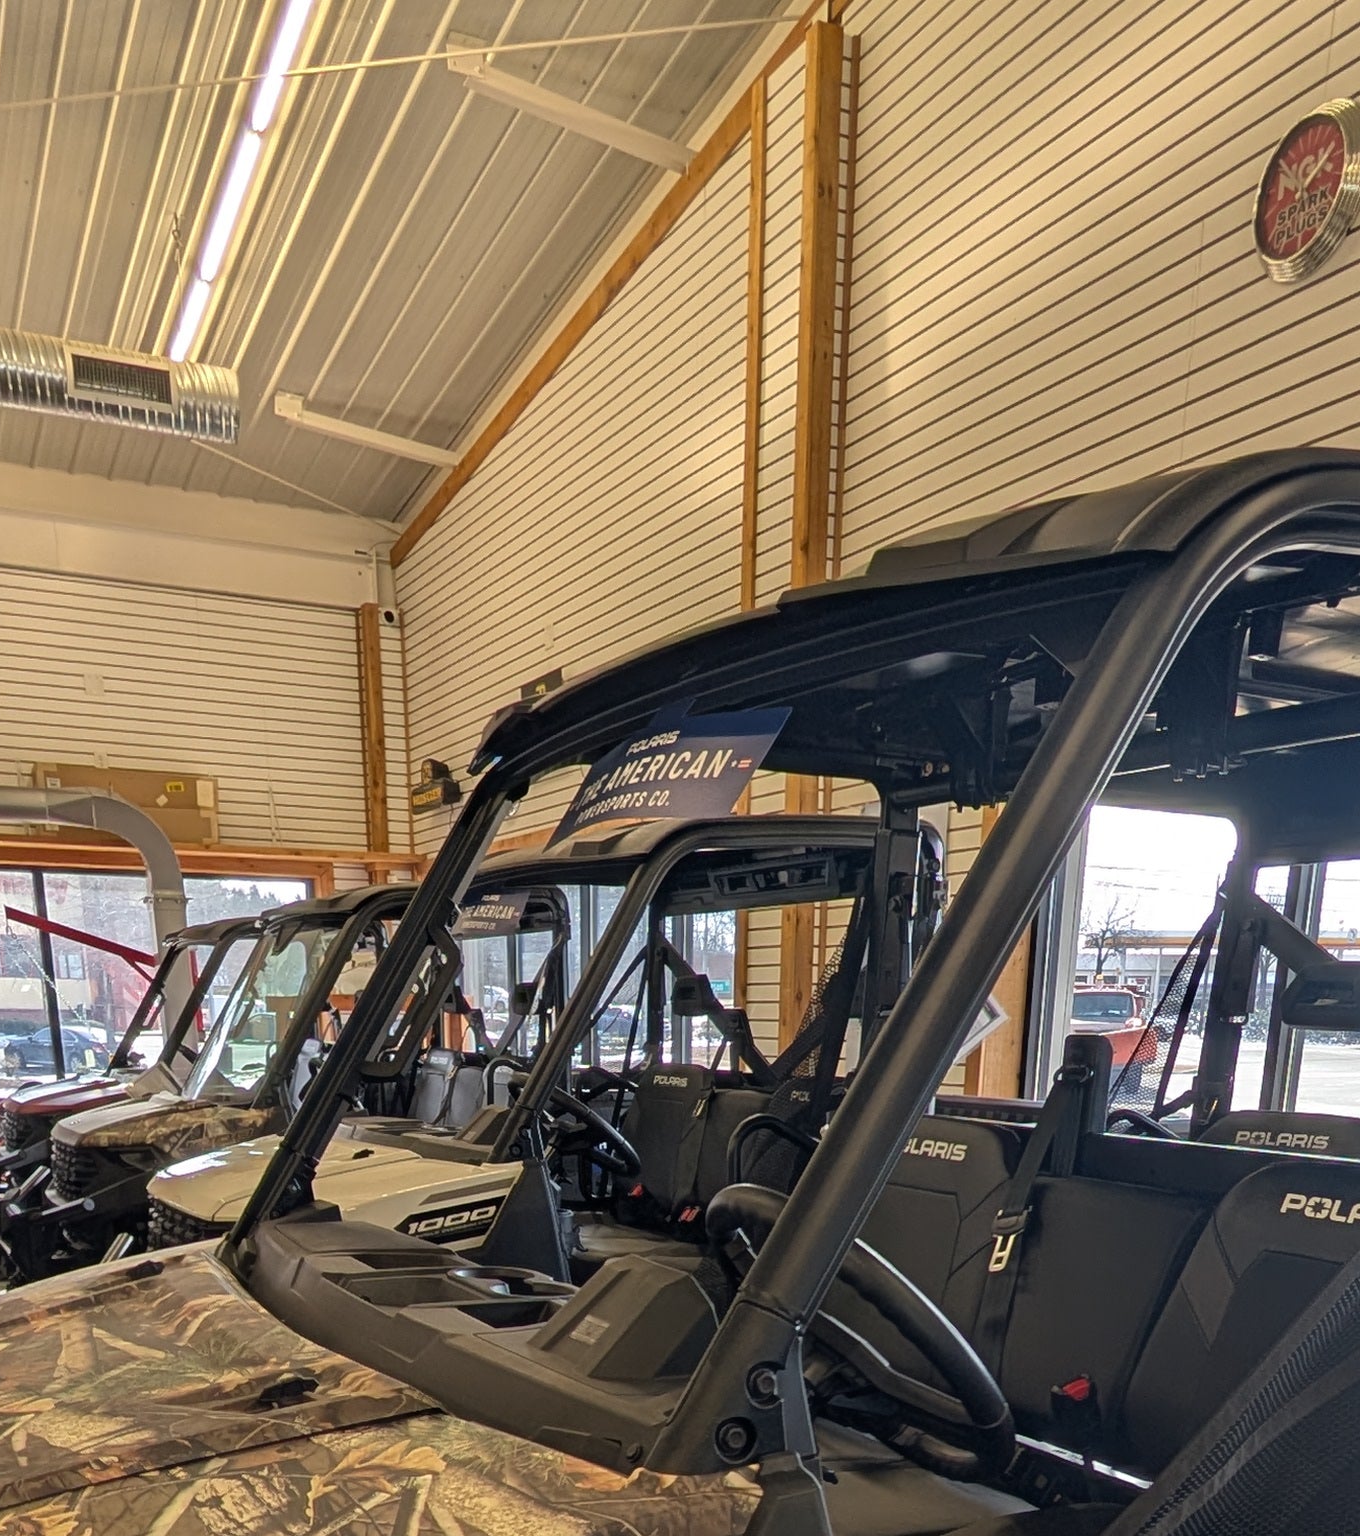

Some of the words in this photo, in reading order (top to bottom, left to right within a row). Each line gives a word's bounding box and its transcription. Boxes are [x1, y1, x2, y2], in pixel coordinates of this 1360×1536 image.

[1277, 147, 1334, 201] NGK
[1277, 186, 1331, 227] SPARK
[1274, 206, 1330, 249] PLUGS
[626, 730, 681, 756] POLARIS
[602, 749, 734, 794] AMERICAN
[574, 791, 648, 826] POWERSPORTS
[648, 790, 671, 807] CO.
[653, 1074, 689, 1088] POLARIS
[904, 1138, 968, 1161] LARIS
[1234, 1130, 1330, 1149] POLARIS
[407, 1205, 497, 1235] 1000
